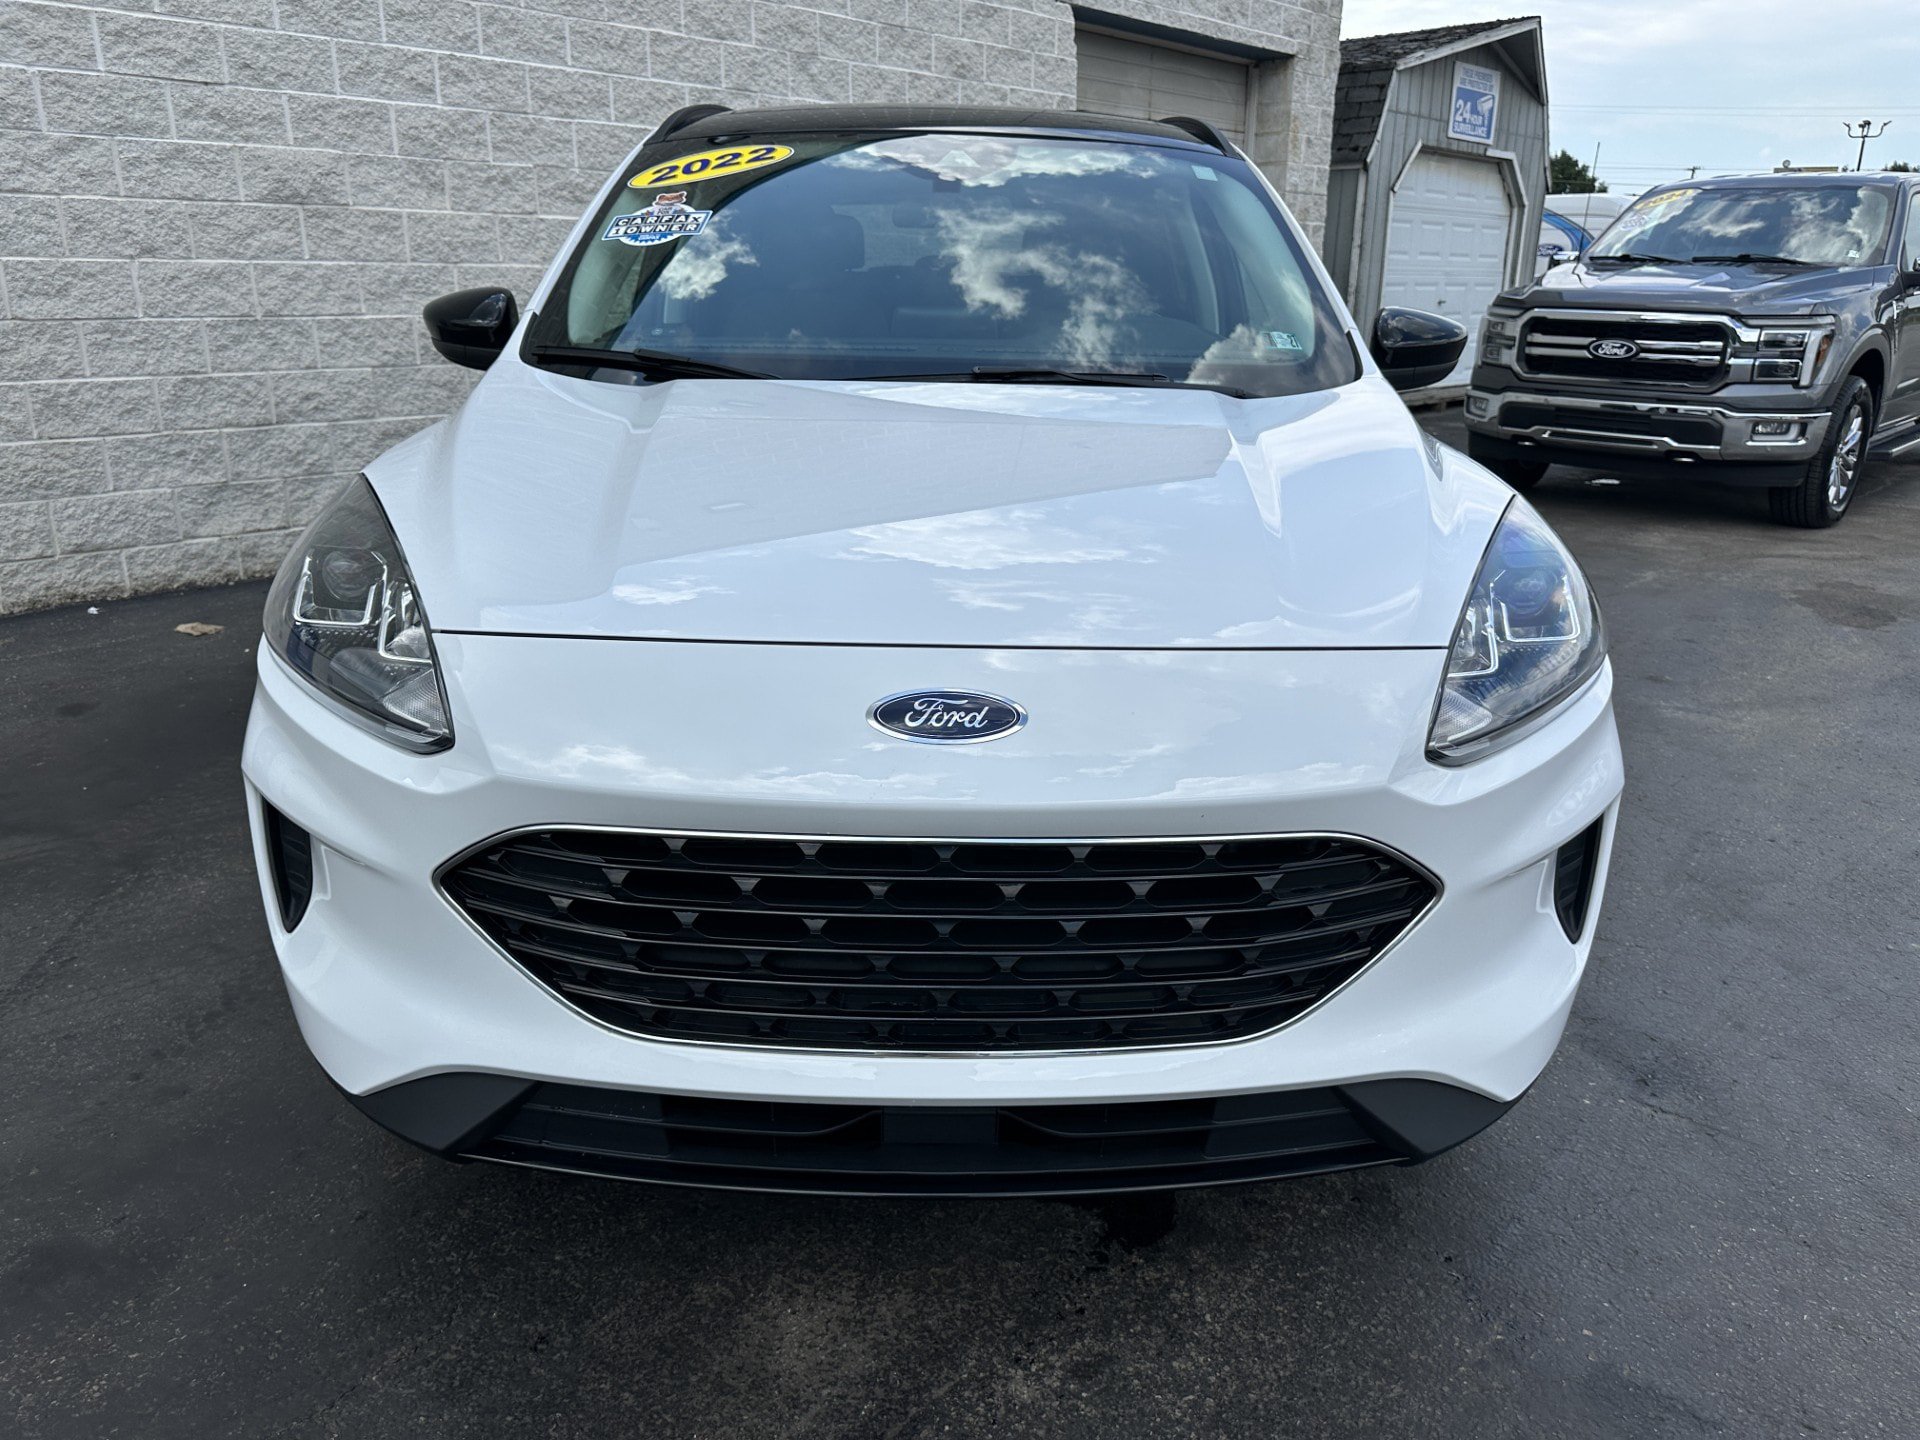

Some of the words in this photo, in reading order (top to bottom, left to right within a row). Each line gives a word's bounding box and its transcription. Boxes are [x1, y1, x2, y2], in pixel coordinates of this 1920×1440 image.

[1455, 99, 1471, 122] 24
[1453, 121, 1488, 137] SURVEILLANCE
[647, 147, 777, 185] 2022
[617, 214, 703, 227] CARFAX
[626, 223, 698, 234] OWNER
[1597, 342, 1628, 356] Ford
[904, 697, 990, 728] Ford
